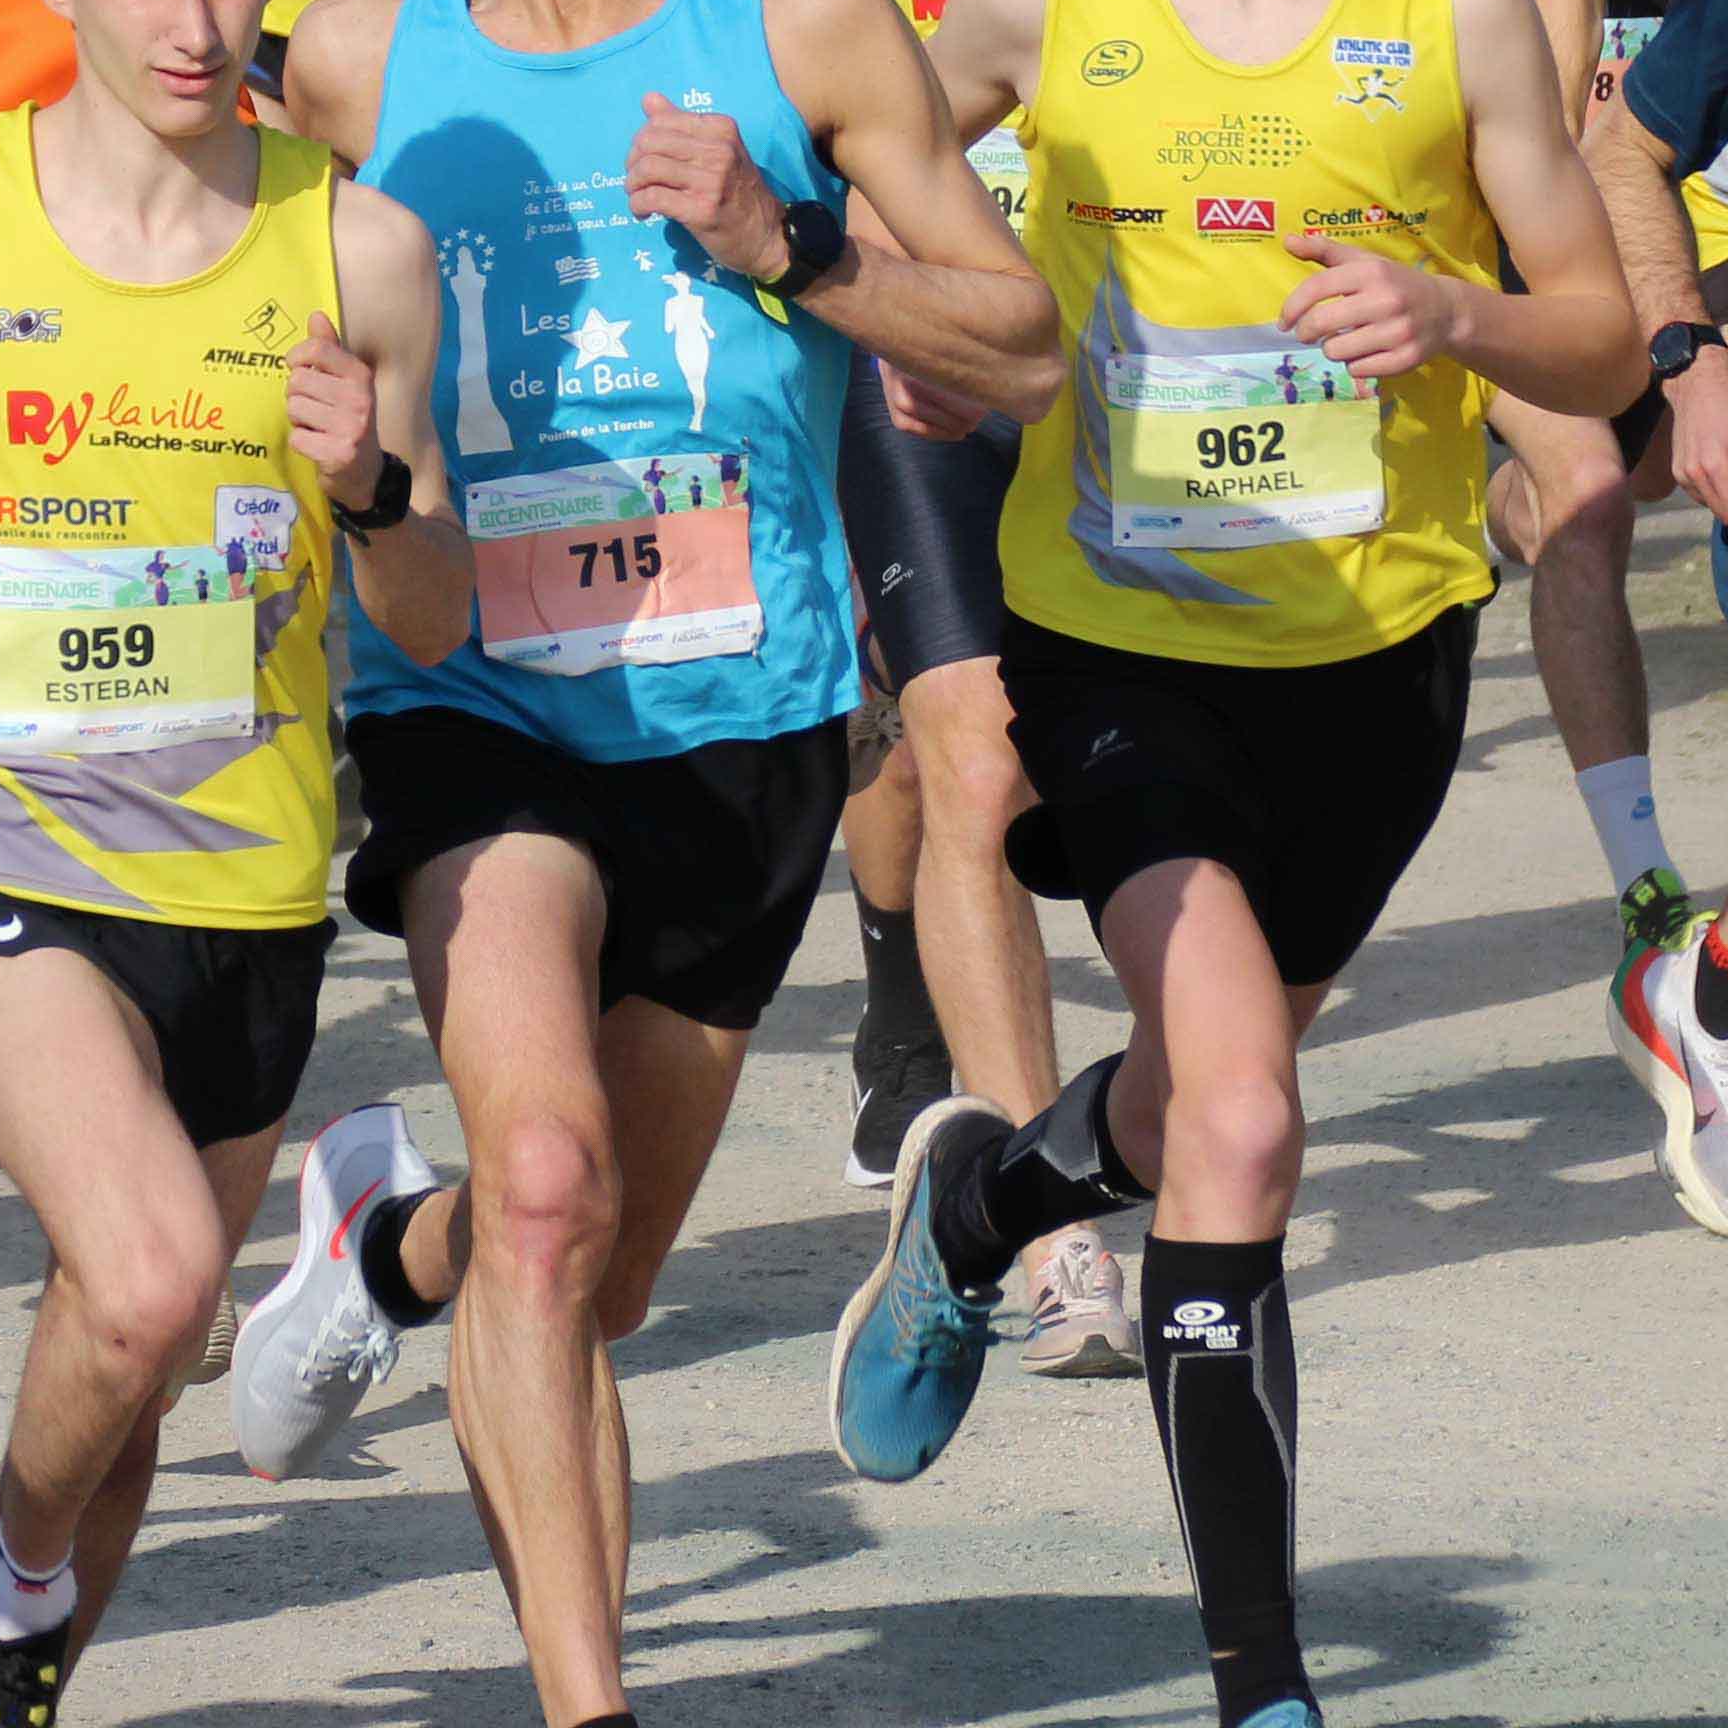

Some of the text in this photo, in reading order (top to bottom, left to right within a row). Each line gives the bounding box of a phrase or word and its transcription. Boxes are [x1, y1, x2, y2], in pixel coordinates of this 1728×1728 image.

[683, 88, 712, 108] tbs
[1221, 114, 1245, 129] LA
[1176, 130, 1244, 147] ROCHE
[1156, 151, 1194, 164] SUR
[1200, 200, 1271, 228] AVA
[1303, 208, 1363, 226] Crédit
[521, 303, 570, 336] Les
[203, 347, 286, 370] ATHLETIC
[509, 363, 660, 399] de la Baie
[1118, 384, 1233, 401] BICENTENAIRE
[6, 382, 225, 465] Ry la ville
[581, 426, 596, 436] de
[598, 422, 610, 434] la
[89, 431, 269, 459] La Roche-sur-Yon
[1197, 421, 1286, 469] 962
[1186, 471, 1304, 498] RAPHAEL
[233, 496, 281, 515] Crédit
[478, 494, 604, 528] BICENTENAIRE
[568, 533, 661, 588] 715
[57, 623, 156, 673] 959
[44, 675, 171, 703] ESTEBAN
[1185, 1324, 1240, 1339] SPORT
